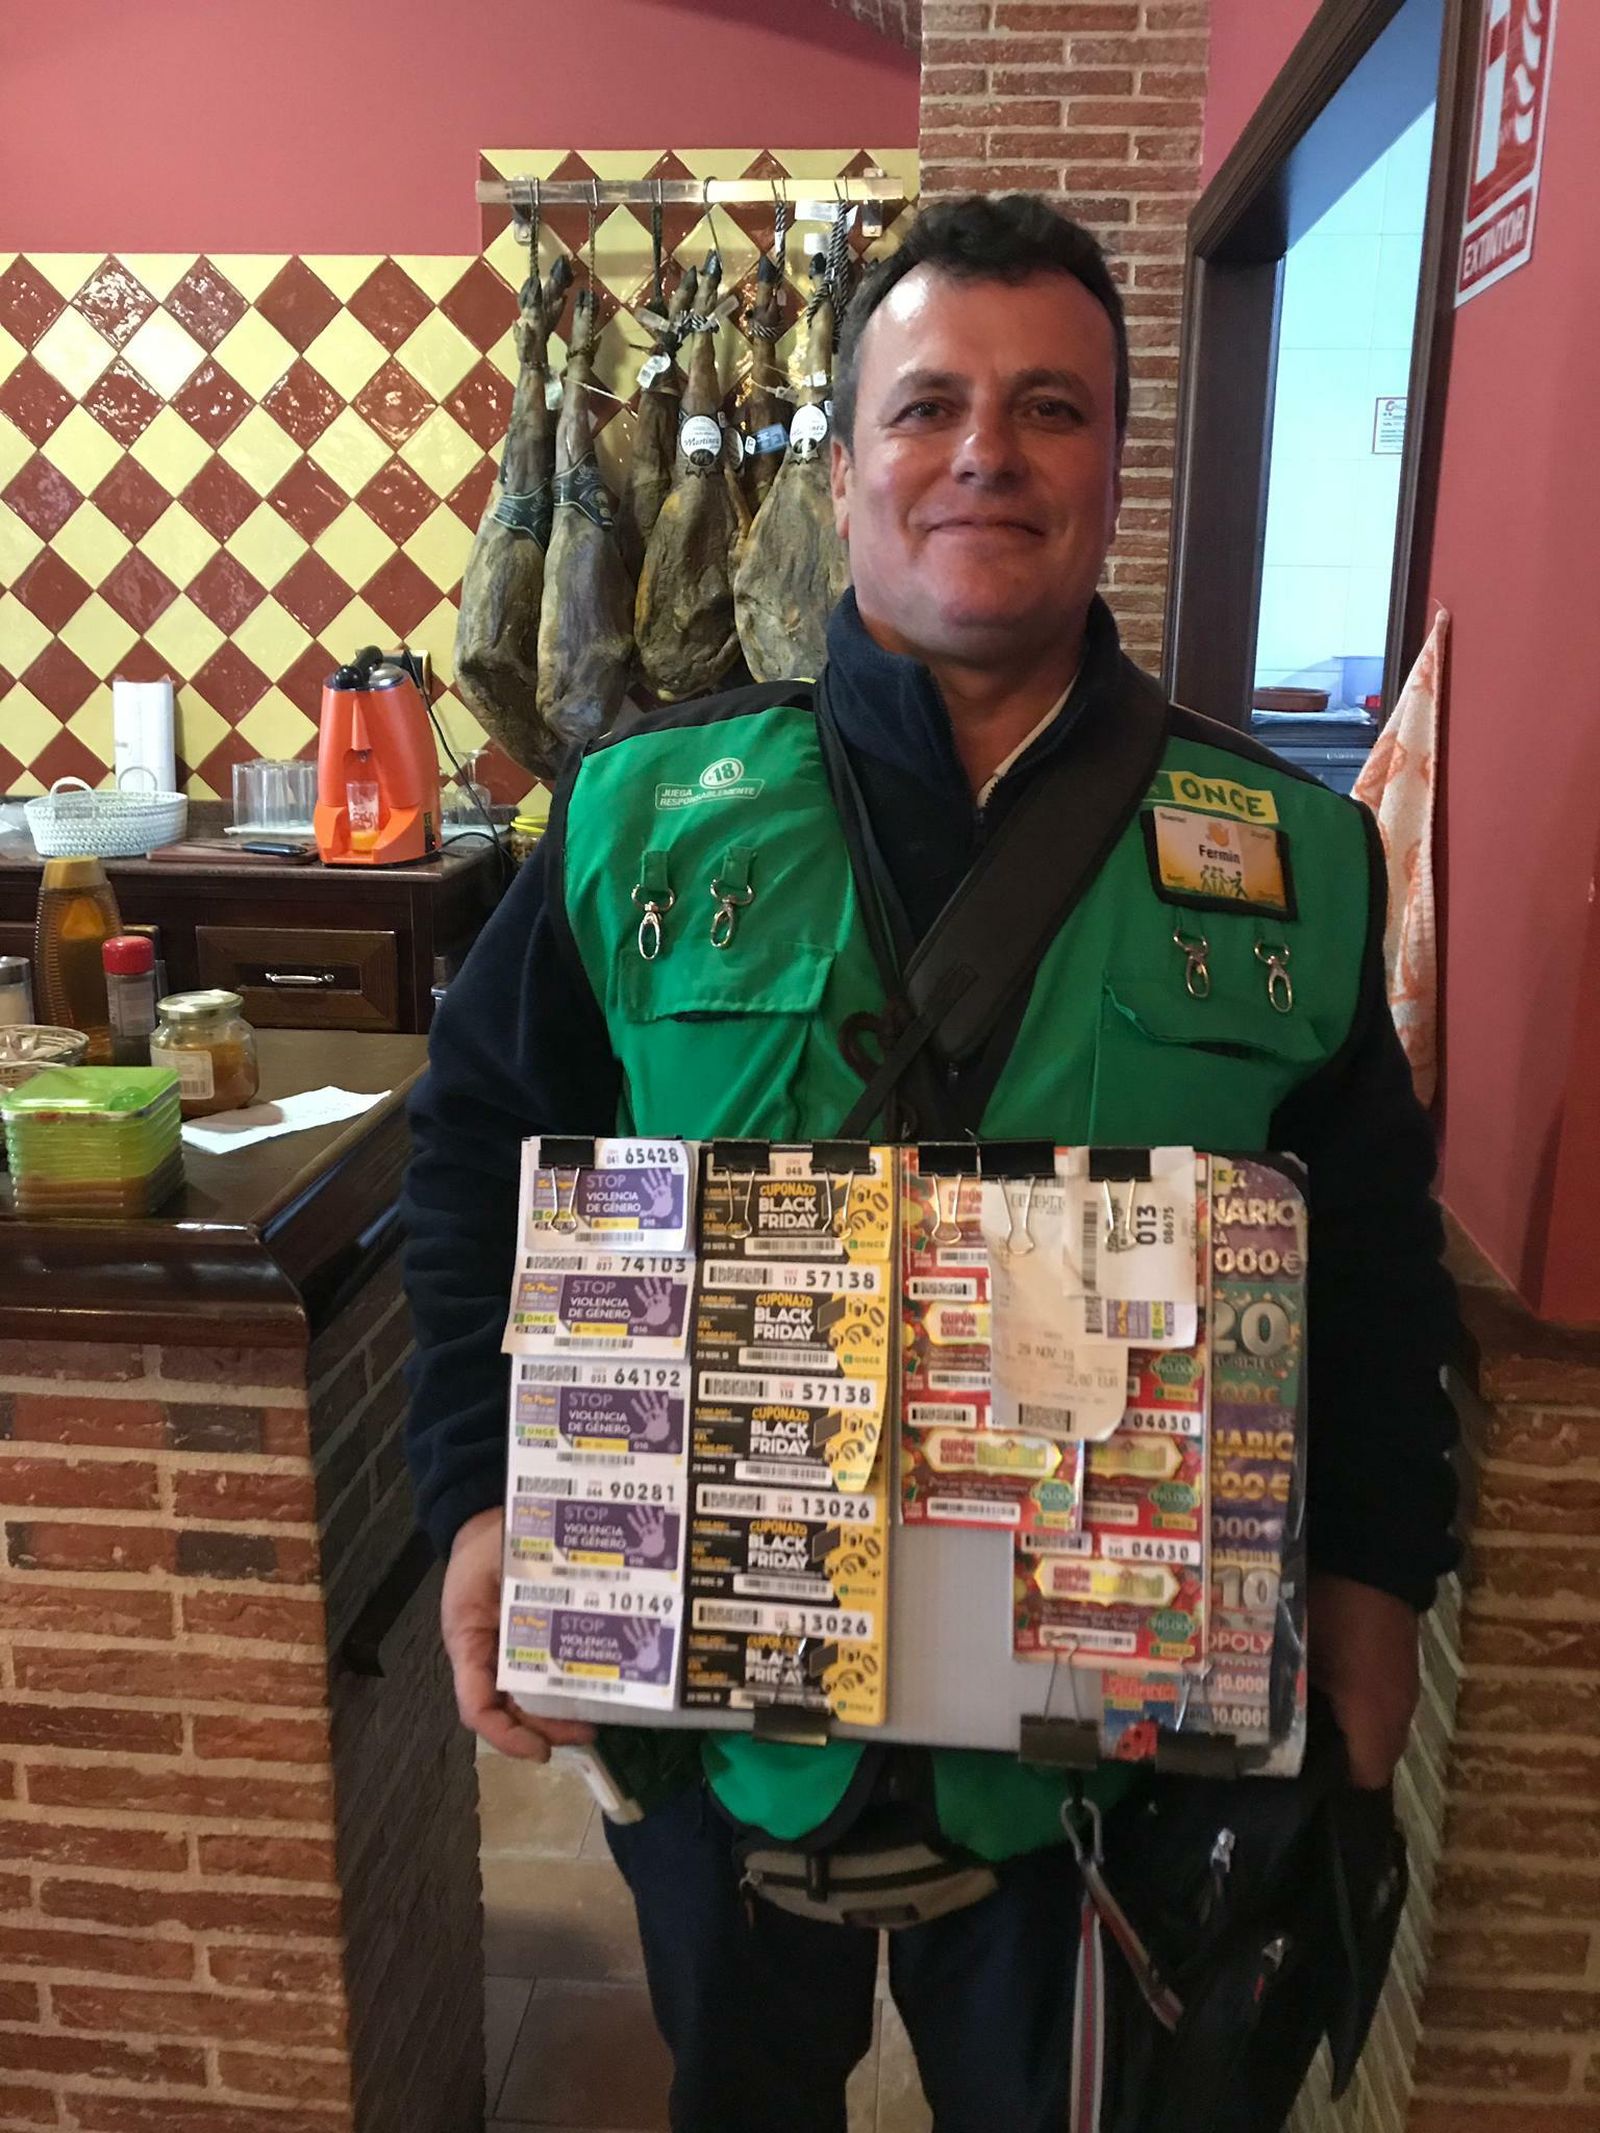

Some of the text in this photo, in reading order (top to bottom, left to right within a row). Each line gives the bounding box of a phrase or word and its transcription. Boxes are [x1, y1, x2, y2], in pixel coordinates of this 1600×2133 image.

[1463, 204, 1526, 280] EXTINTOR
[660, 787, 755, 806] RESPONSABLEMENTE
[662, 788, 692, 797] JUEGA
[1180, 778, 1266, 817] ONCE
[625, 1147, 679, 1164] 65428
[586, 1174, 626, 1188] STOP
[586, 1190, 638, 1201] VIOLENCIA
[759, 1182, 817, 1197] CUPONAZO
[586, 1200, 641, 1213] DE GÉNERO
[759, 1197, 816, 1212] BLACK
[759, 1213, 819, 1229] FRIDAY
[1136, 1205, 1157, 1245] 013
[621, 1257, 687, 1273] 74103
[572, 1280, 617, 1294] STOP
[805, 1270, 875, 1289] 57138
[570, 1297, 629, 1307] VIOLENCIA
[755, 1293, 813, 1308] CUPONAZO
[568, 1308, 582, 1318] DE
[754, 1307, 813, 1324] BLACK
[753, 1325, 815, 1341] FRIDAY
[614, 1367, 680, 1387] 64192
[568, 1391, 613, 1407] STOP
[802, 1383, 871, 1404] 57138
[568, 1410, 627, 1421] VIOLENCIA
[751, 1407, 810, 1422] CUPONAZO
[568, 1423, 582, 1433] DE
[750, 1421, 808, 1439] BLACK
[750, 1438, 811, 1456] FRIDAY
[610, 1482, 674, 1502] 90281
[564, 1504, 609, 1522] STOP
[801, 1497, 870, 1520] 13026
[564, 1522, 624, 1536] VIOLENCIA
[749, 1520, 808, 1536] CUPONAZO
[564, 1536, 578, 1546] DE
[748, 1534, 808, 1553] BLACK
[1132, 1543, 1189, 1560] 04630
[748, 1552, 809, 1571] FRIDAY
[609, 1592, 673, 1614] 10149
[560, 1616, 604, 1632] STOP
[799, 1614, 867, 1635] 13026
[560, 1635, 618, 1649] VIOLENCIA
[559, 1647, 573, 1658] DE
